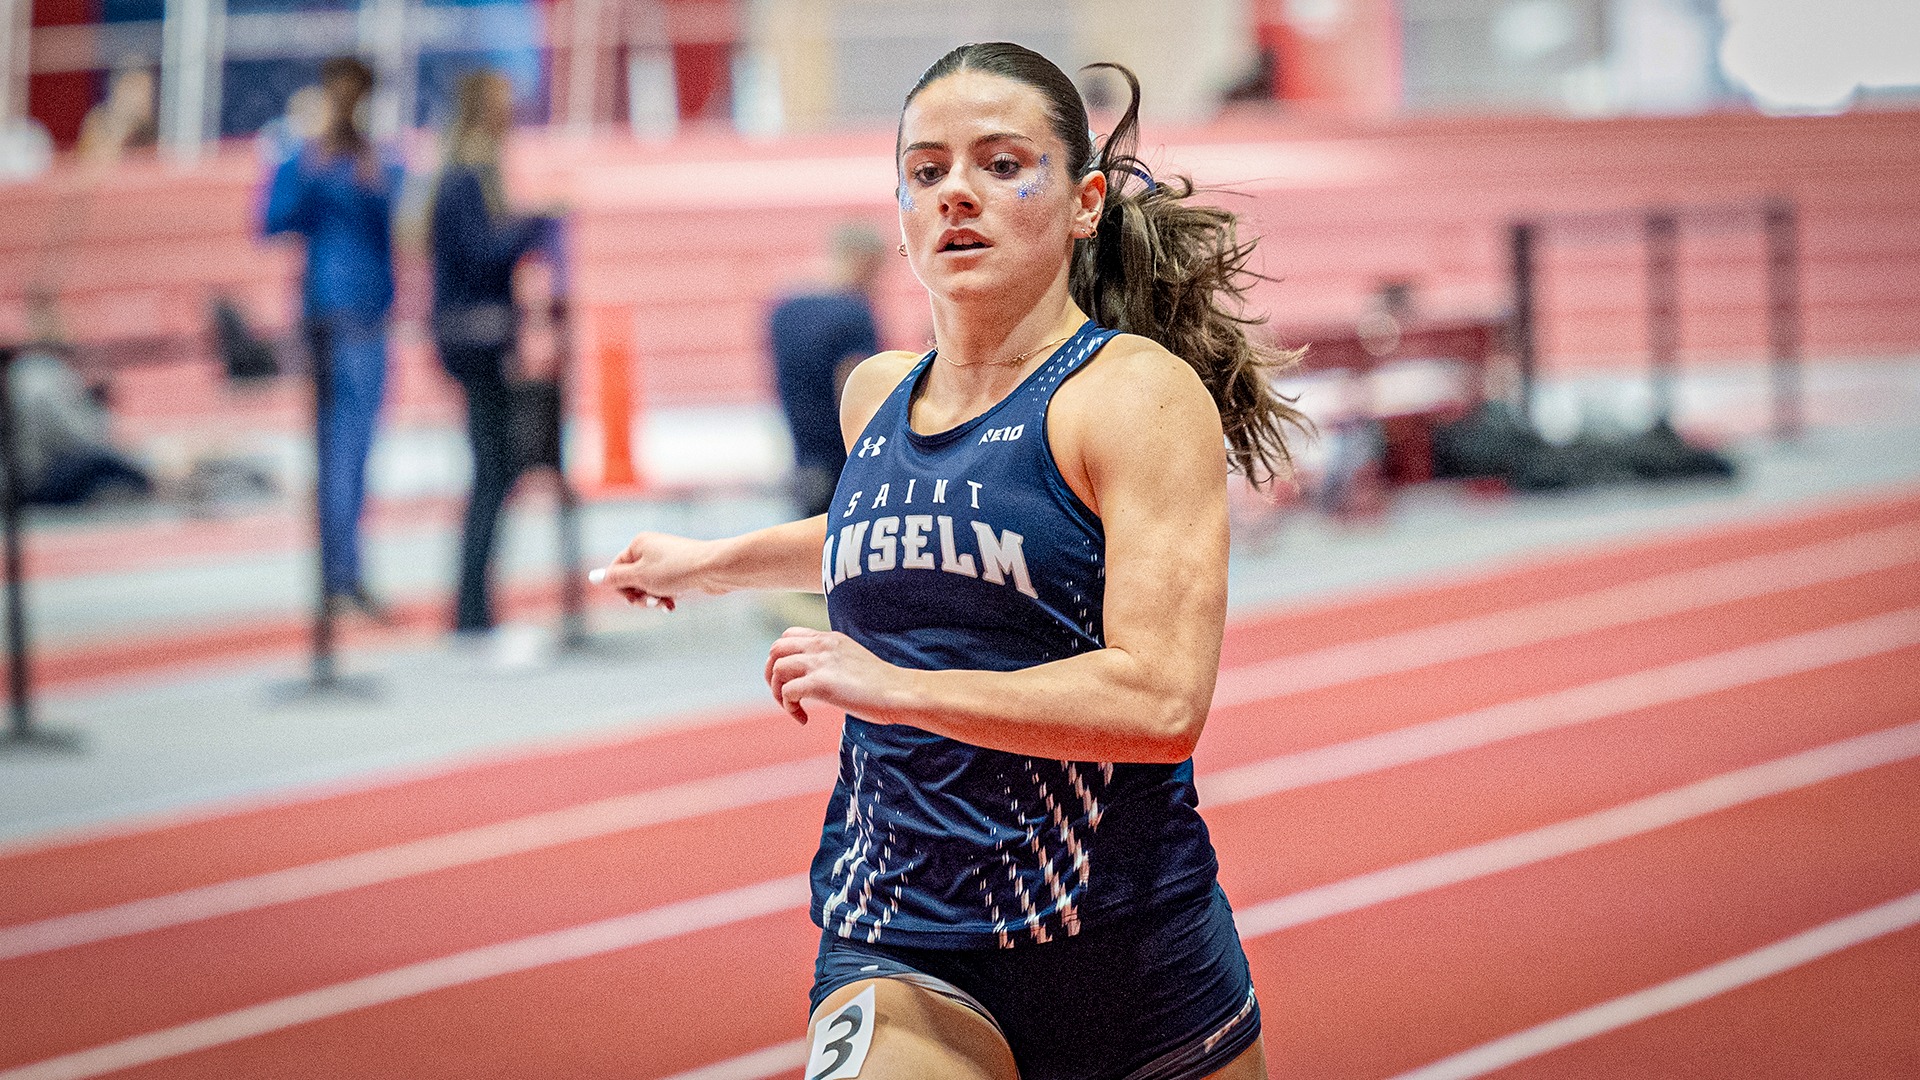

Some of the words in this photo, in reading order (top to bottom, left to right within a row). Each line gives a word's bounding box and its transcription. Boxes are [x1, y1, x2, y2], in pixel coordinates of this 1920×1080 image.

[843, 479, 983, 518] SAINT
[822, 515, 1038, 599] ANSELM
[811, 1004, 863, 1080] 3
